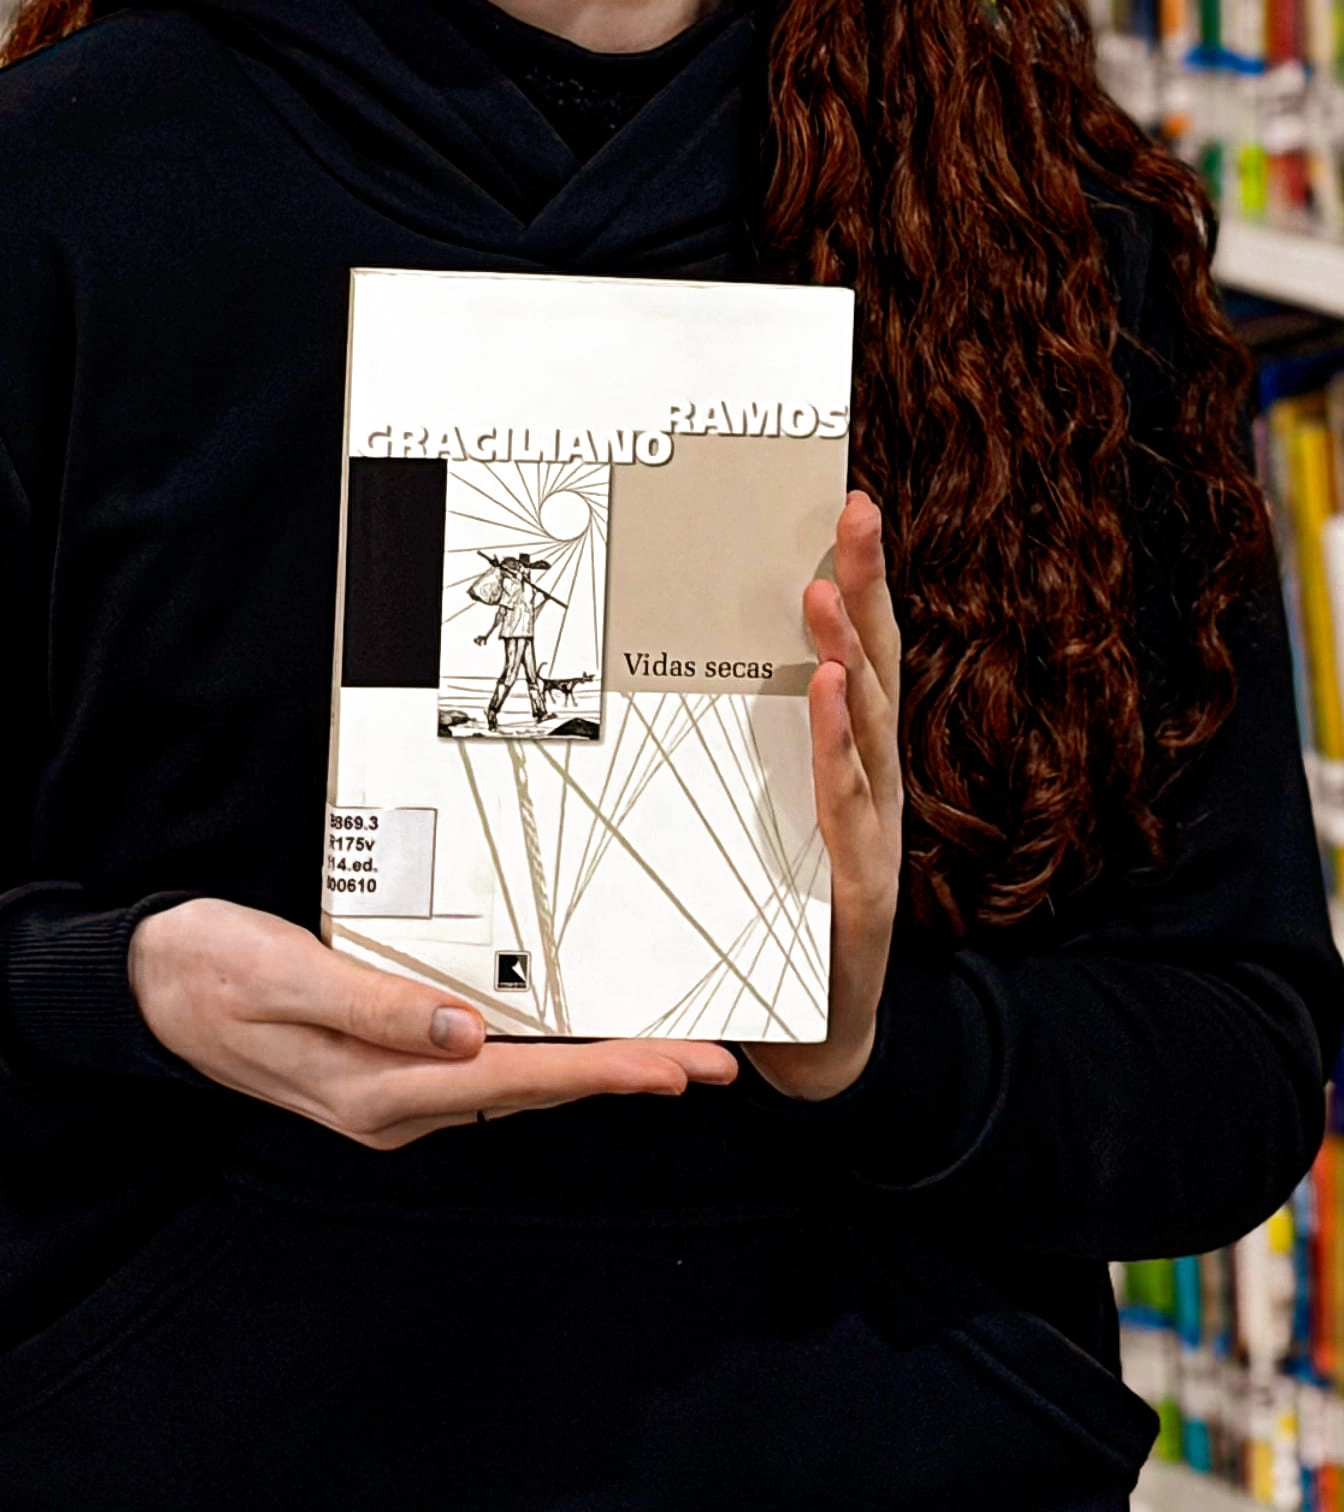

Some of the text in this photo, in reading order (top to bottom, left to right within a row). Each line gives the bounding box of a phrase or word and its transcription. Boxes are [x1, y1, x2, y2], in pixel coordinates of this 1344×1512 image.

[358, 400, 849, 467] GRACILIANO RAMOS
[623, 651, 774, 680] Vidas secas
